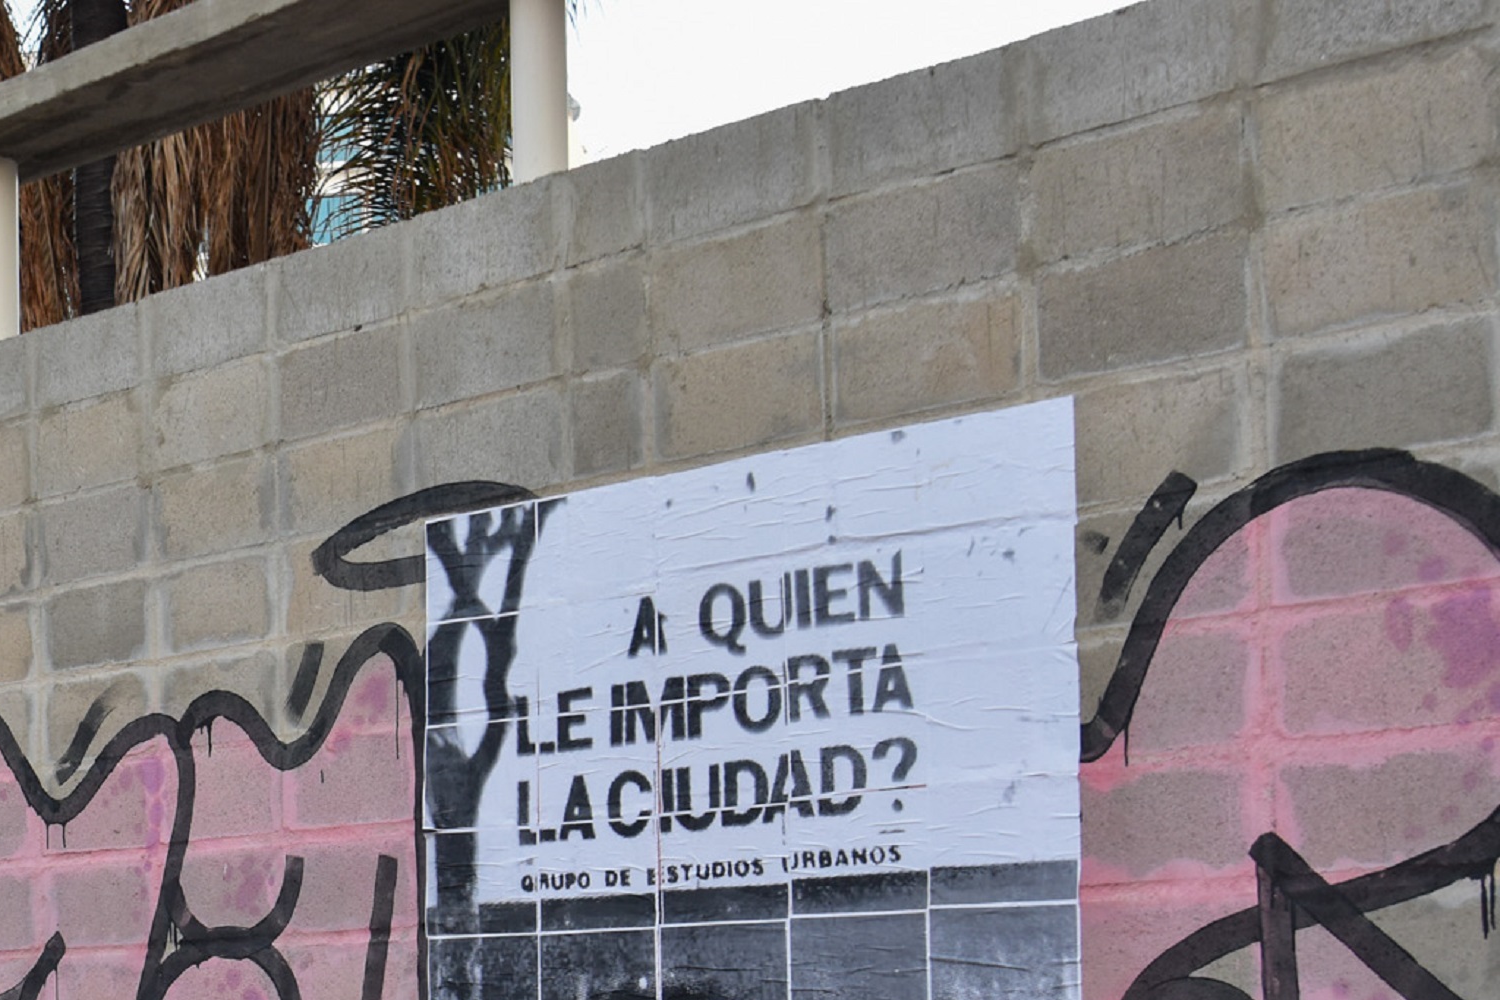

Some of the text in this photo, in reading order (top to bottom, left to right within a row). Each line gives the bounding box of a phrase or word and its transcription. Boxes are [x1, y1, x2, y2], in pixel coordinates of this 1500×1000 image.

[627, 549, 905, 657] A QUIEN
[515, 643, 915, 756] LE IMPORTA
[517, 736, 918, 845] LA CIUDAD?
[520, 844, 902, 893] GRUPO DE ESTUDIOS URBANOS
